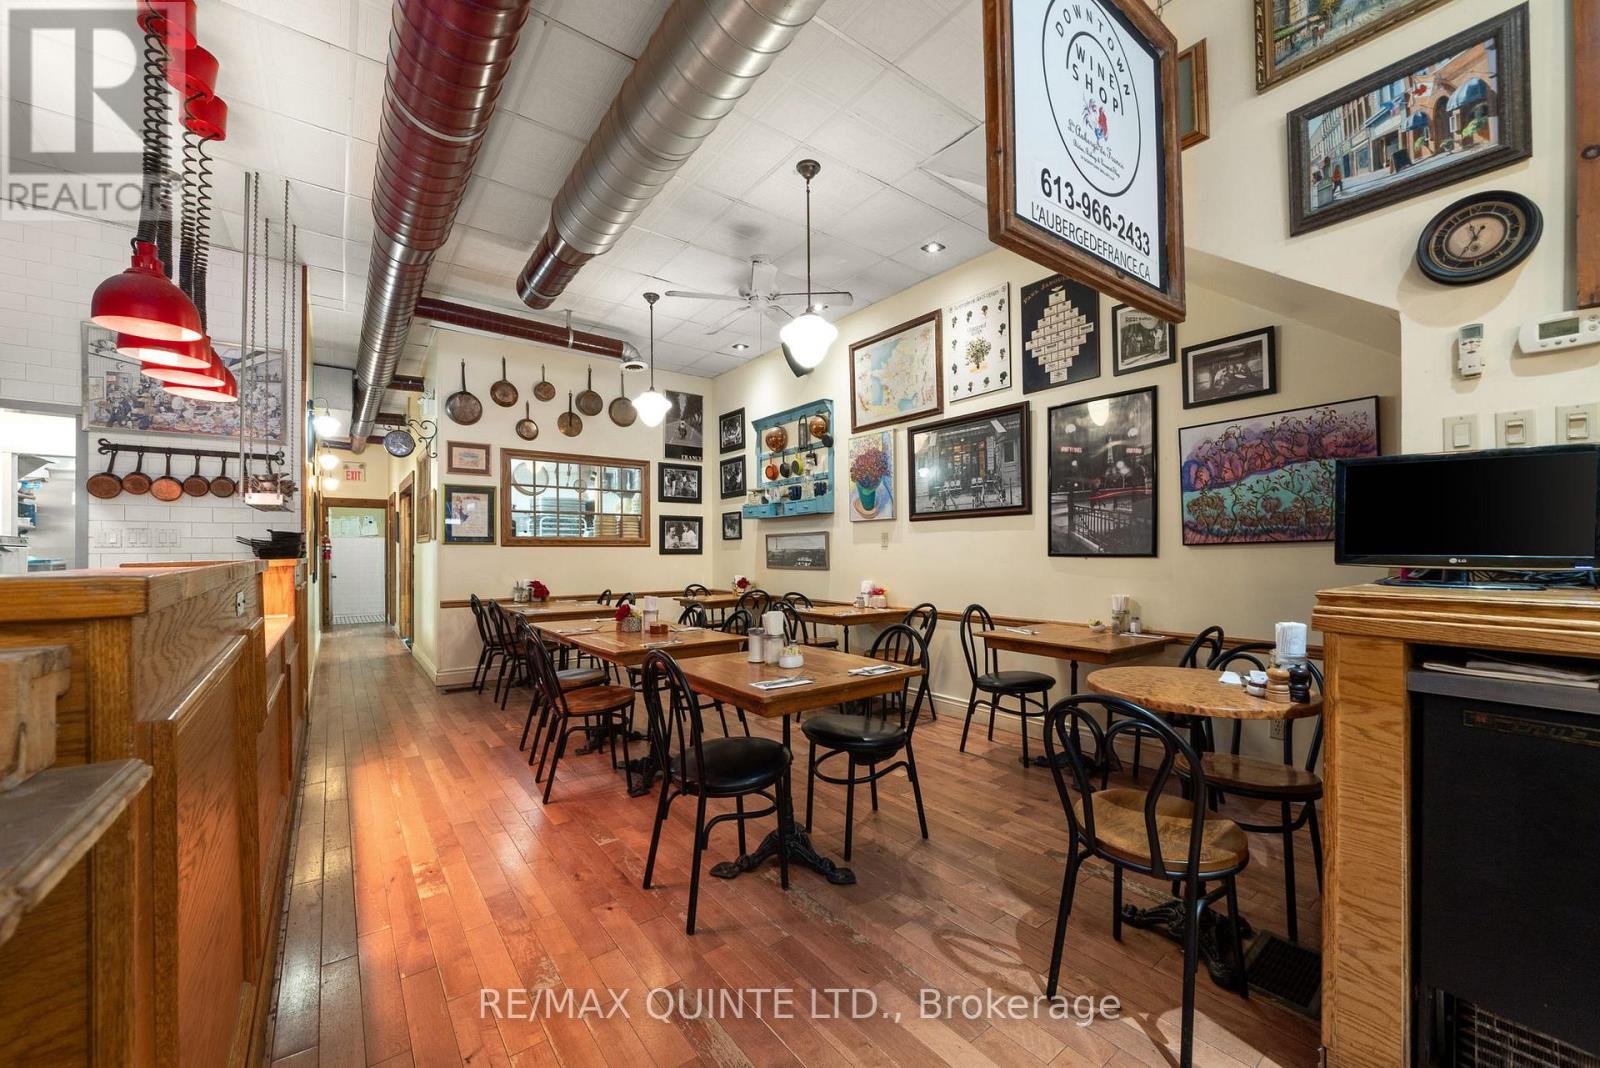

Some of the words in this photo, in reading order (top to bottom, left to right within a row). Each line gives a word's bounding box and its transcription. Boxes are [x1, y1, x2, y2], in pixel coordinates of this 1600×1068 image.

[1055, 4, 1130, 95] DOWNTOWN
[1075, 42, 1115, 90] WINE
[1072, 63, 1119, 112] SHOP
[1031, 200, 1151, 281] L'AUBERGEDEFRANCE.CA
[1040, 167, 1151, 257] 613-966-2433
[345, 470, 361, 481] EXIT
